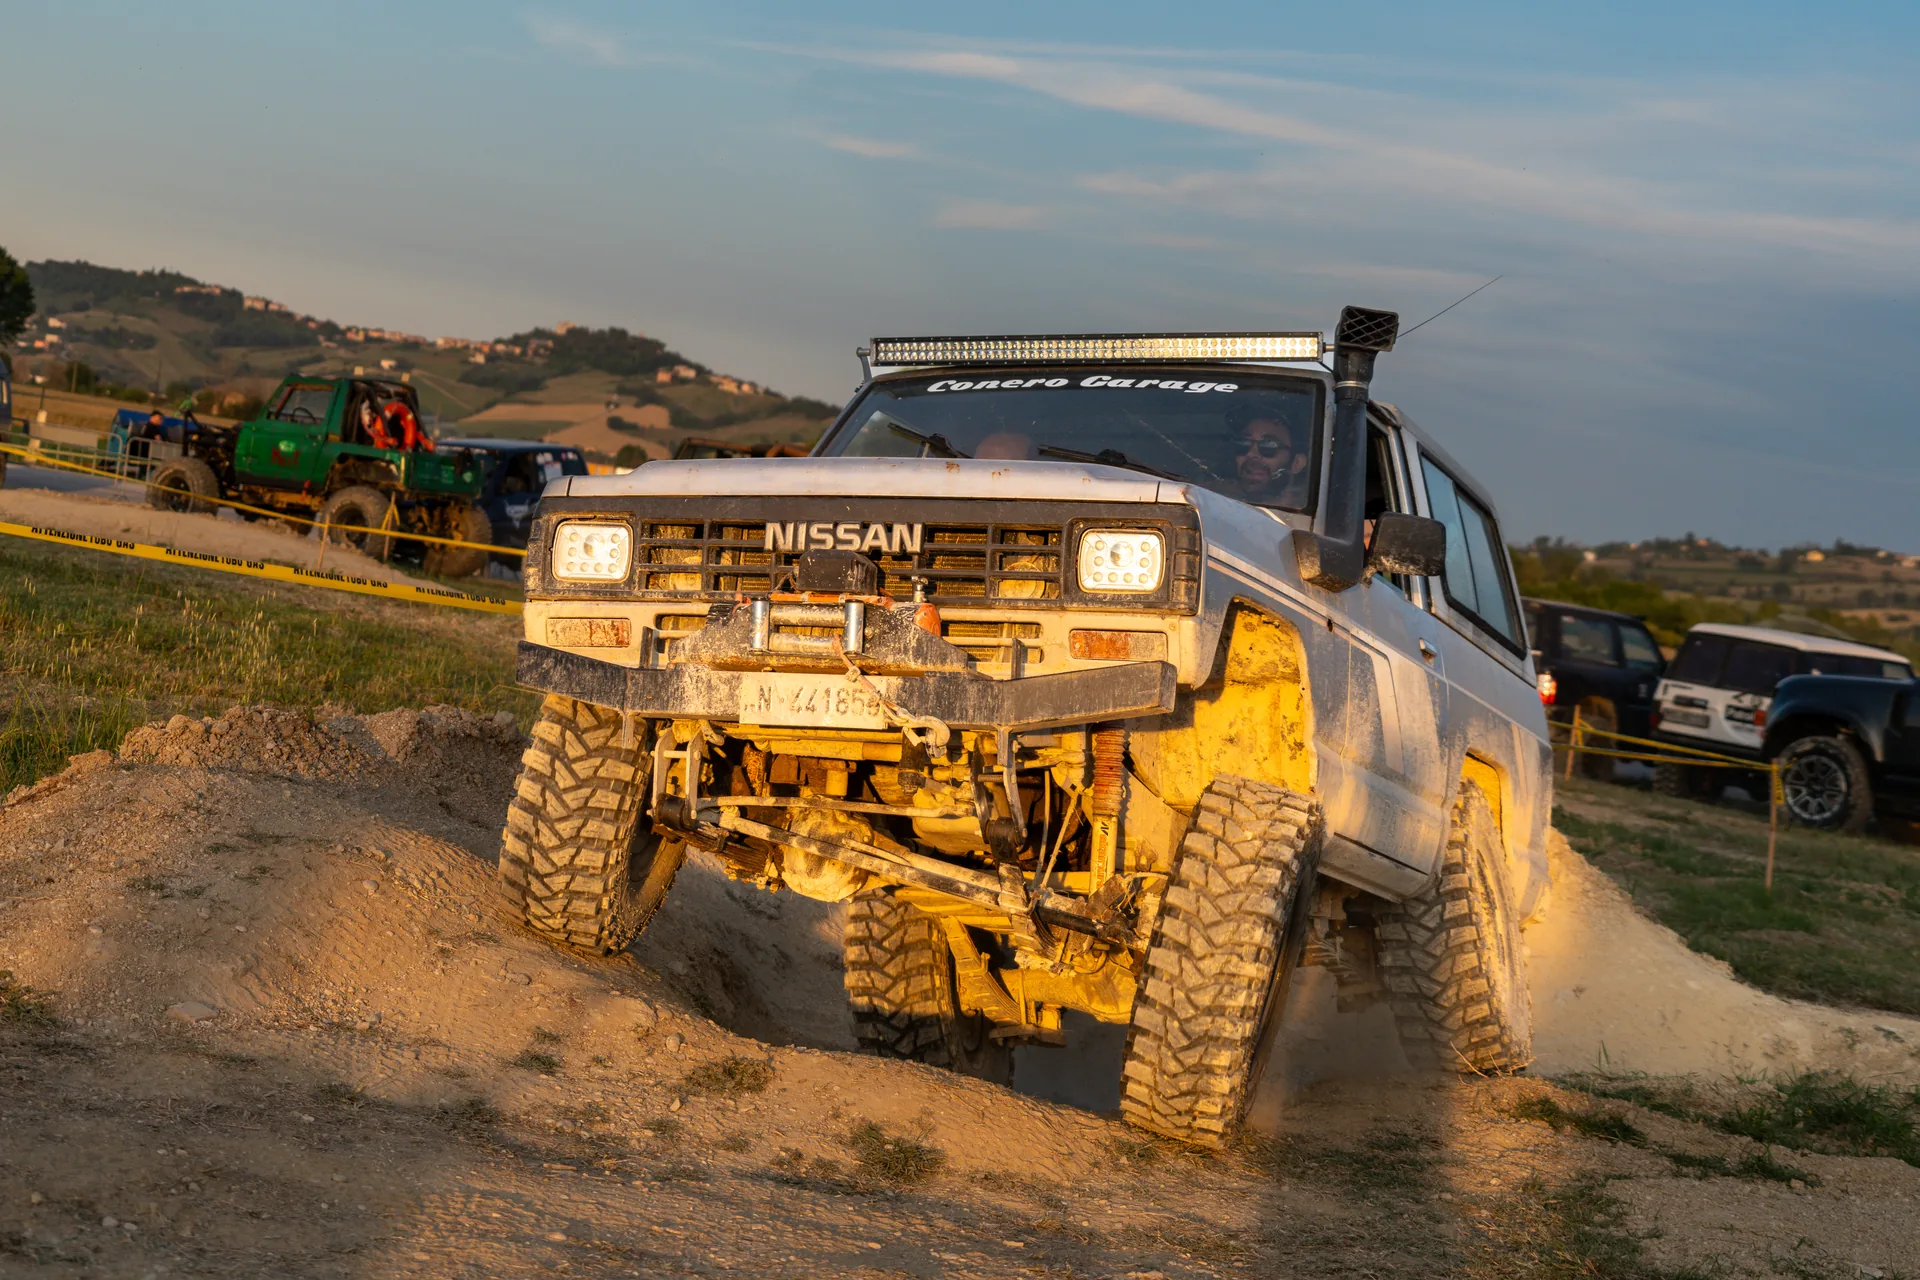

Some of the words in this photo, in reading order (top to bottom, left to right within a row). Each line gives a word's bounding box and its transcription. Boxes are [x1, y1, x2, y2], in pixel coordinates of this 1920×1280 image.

[926, 377, 1069, 393] Conero
[1080, 375, 1239, 394] Garage
[763, 520, 924, 554] NISSAN
